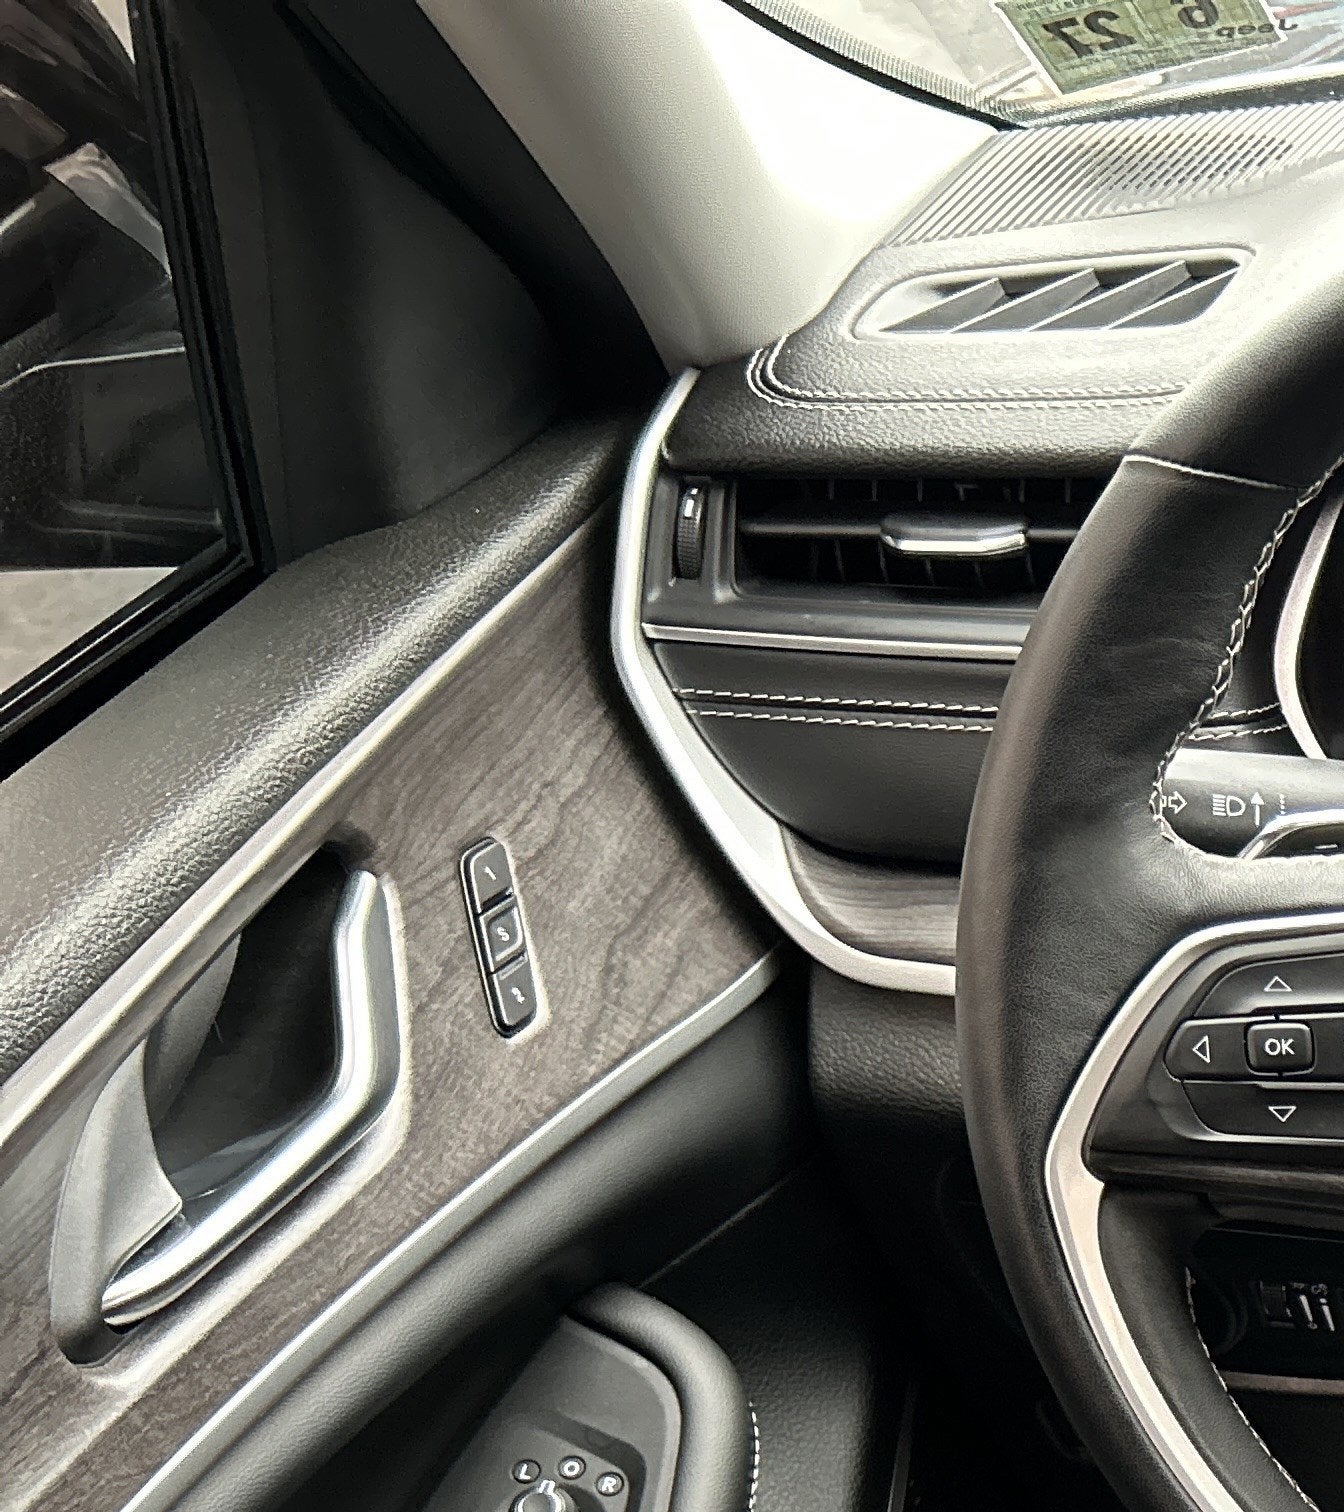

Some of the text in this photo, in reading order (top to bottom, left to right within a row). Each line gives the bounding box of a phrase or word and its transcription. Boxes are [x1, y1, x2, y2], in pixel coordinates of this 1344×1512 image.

[484, 866, 497, 881] 1
[496, 927, 510, 942] S
[511, 987, 526, 1004] 2
[1264, 1037, 1295, 1056] OK
[519, 1464, 532, 1480] L
[563, 1461, 580, 1476] O
[602, 1477, 618, 1493] R
